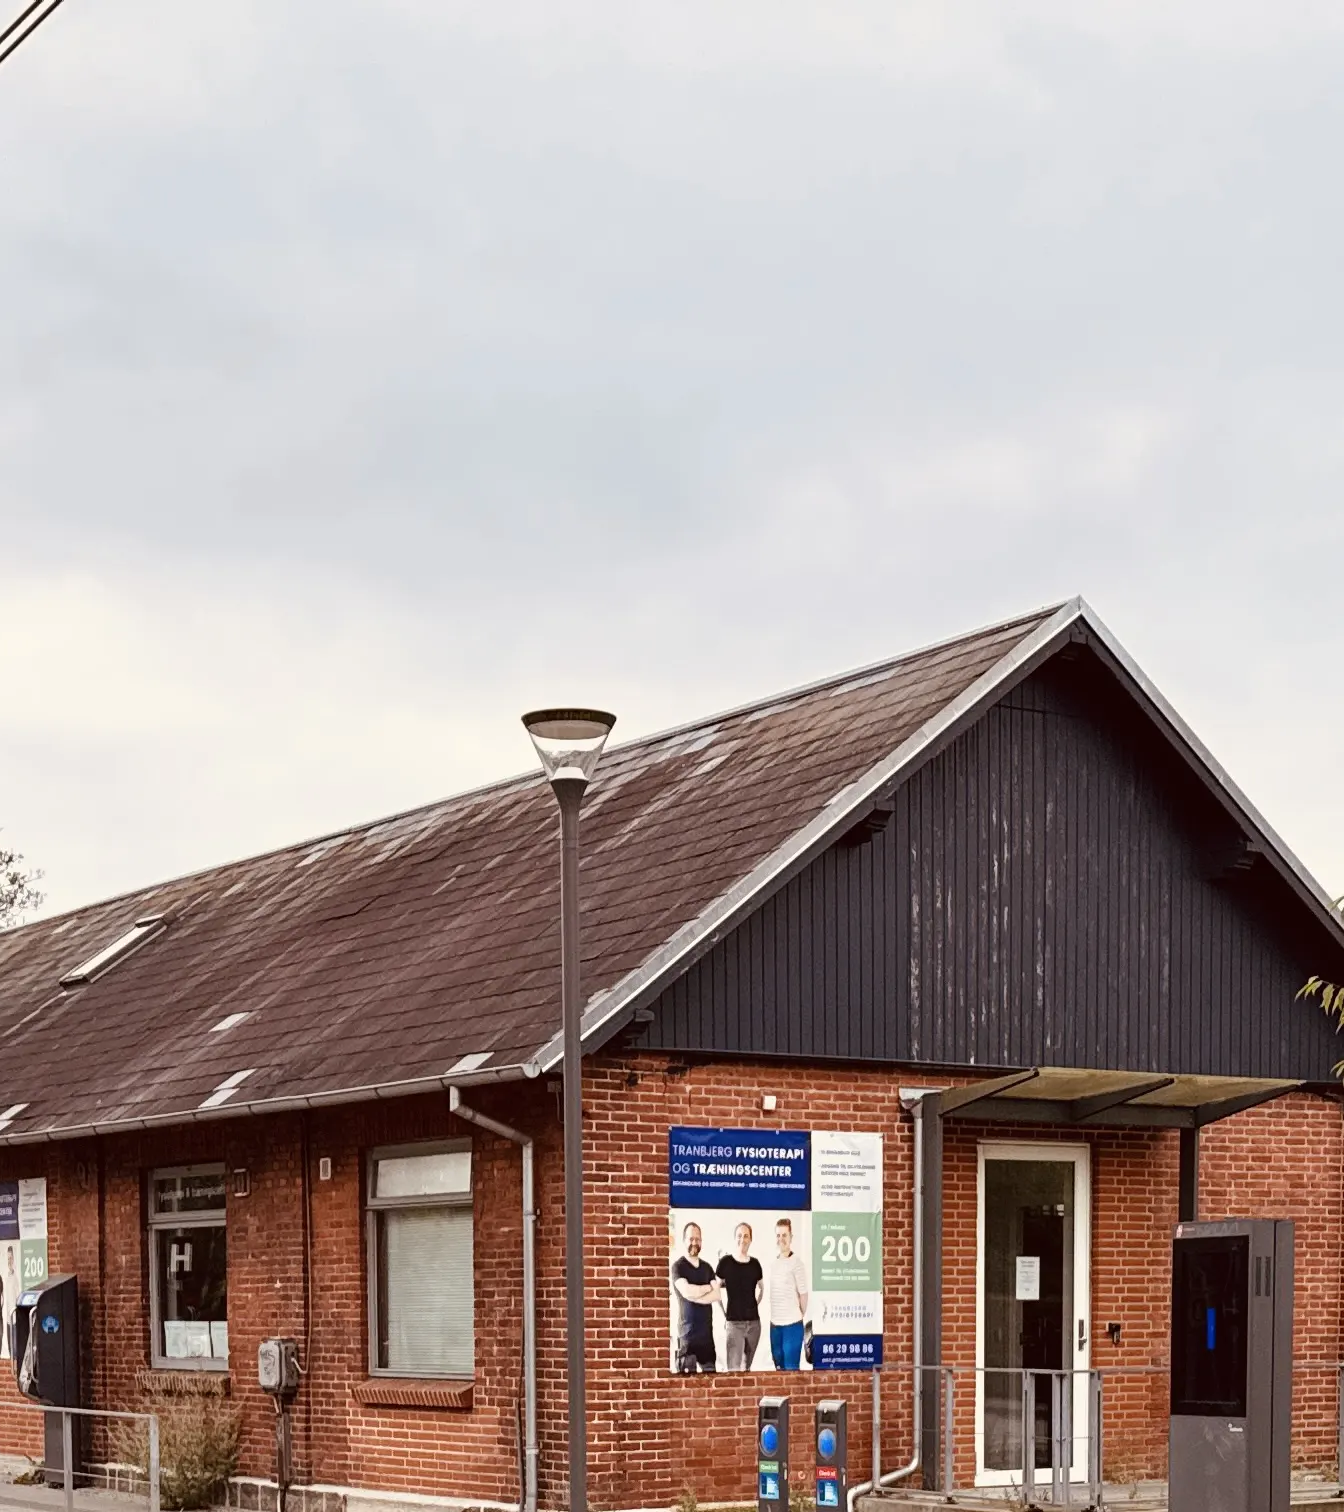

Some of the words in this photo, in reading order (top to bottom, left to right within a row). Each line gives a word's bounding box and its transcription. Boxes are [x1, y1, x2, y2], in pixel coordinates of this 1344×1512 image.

[672, 1145, 732, 1157] TRANBJERG
[735, 1147, 804, 1159] FYSIOTERAPI
[672, 1162, 690, 1174] OG
[693, 1163, 792, 1177] TRÆNINGSCENTER
[821, 1235, 871, 1262] 200
[24, 1256, 44, 1277] 200
